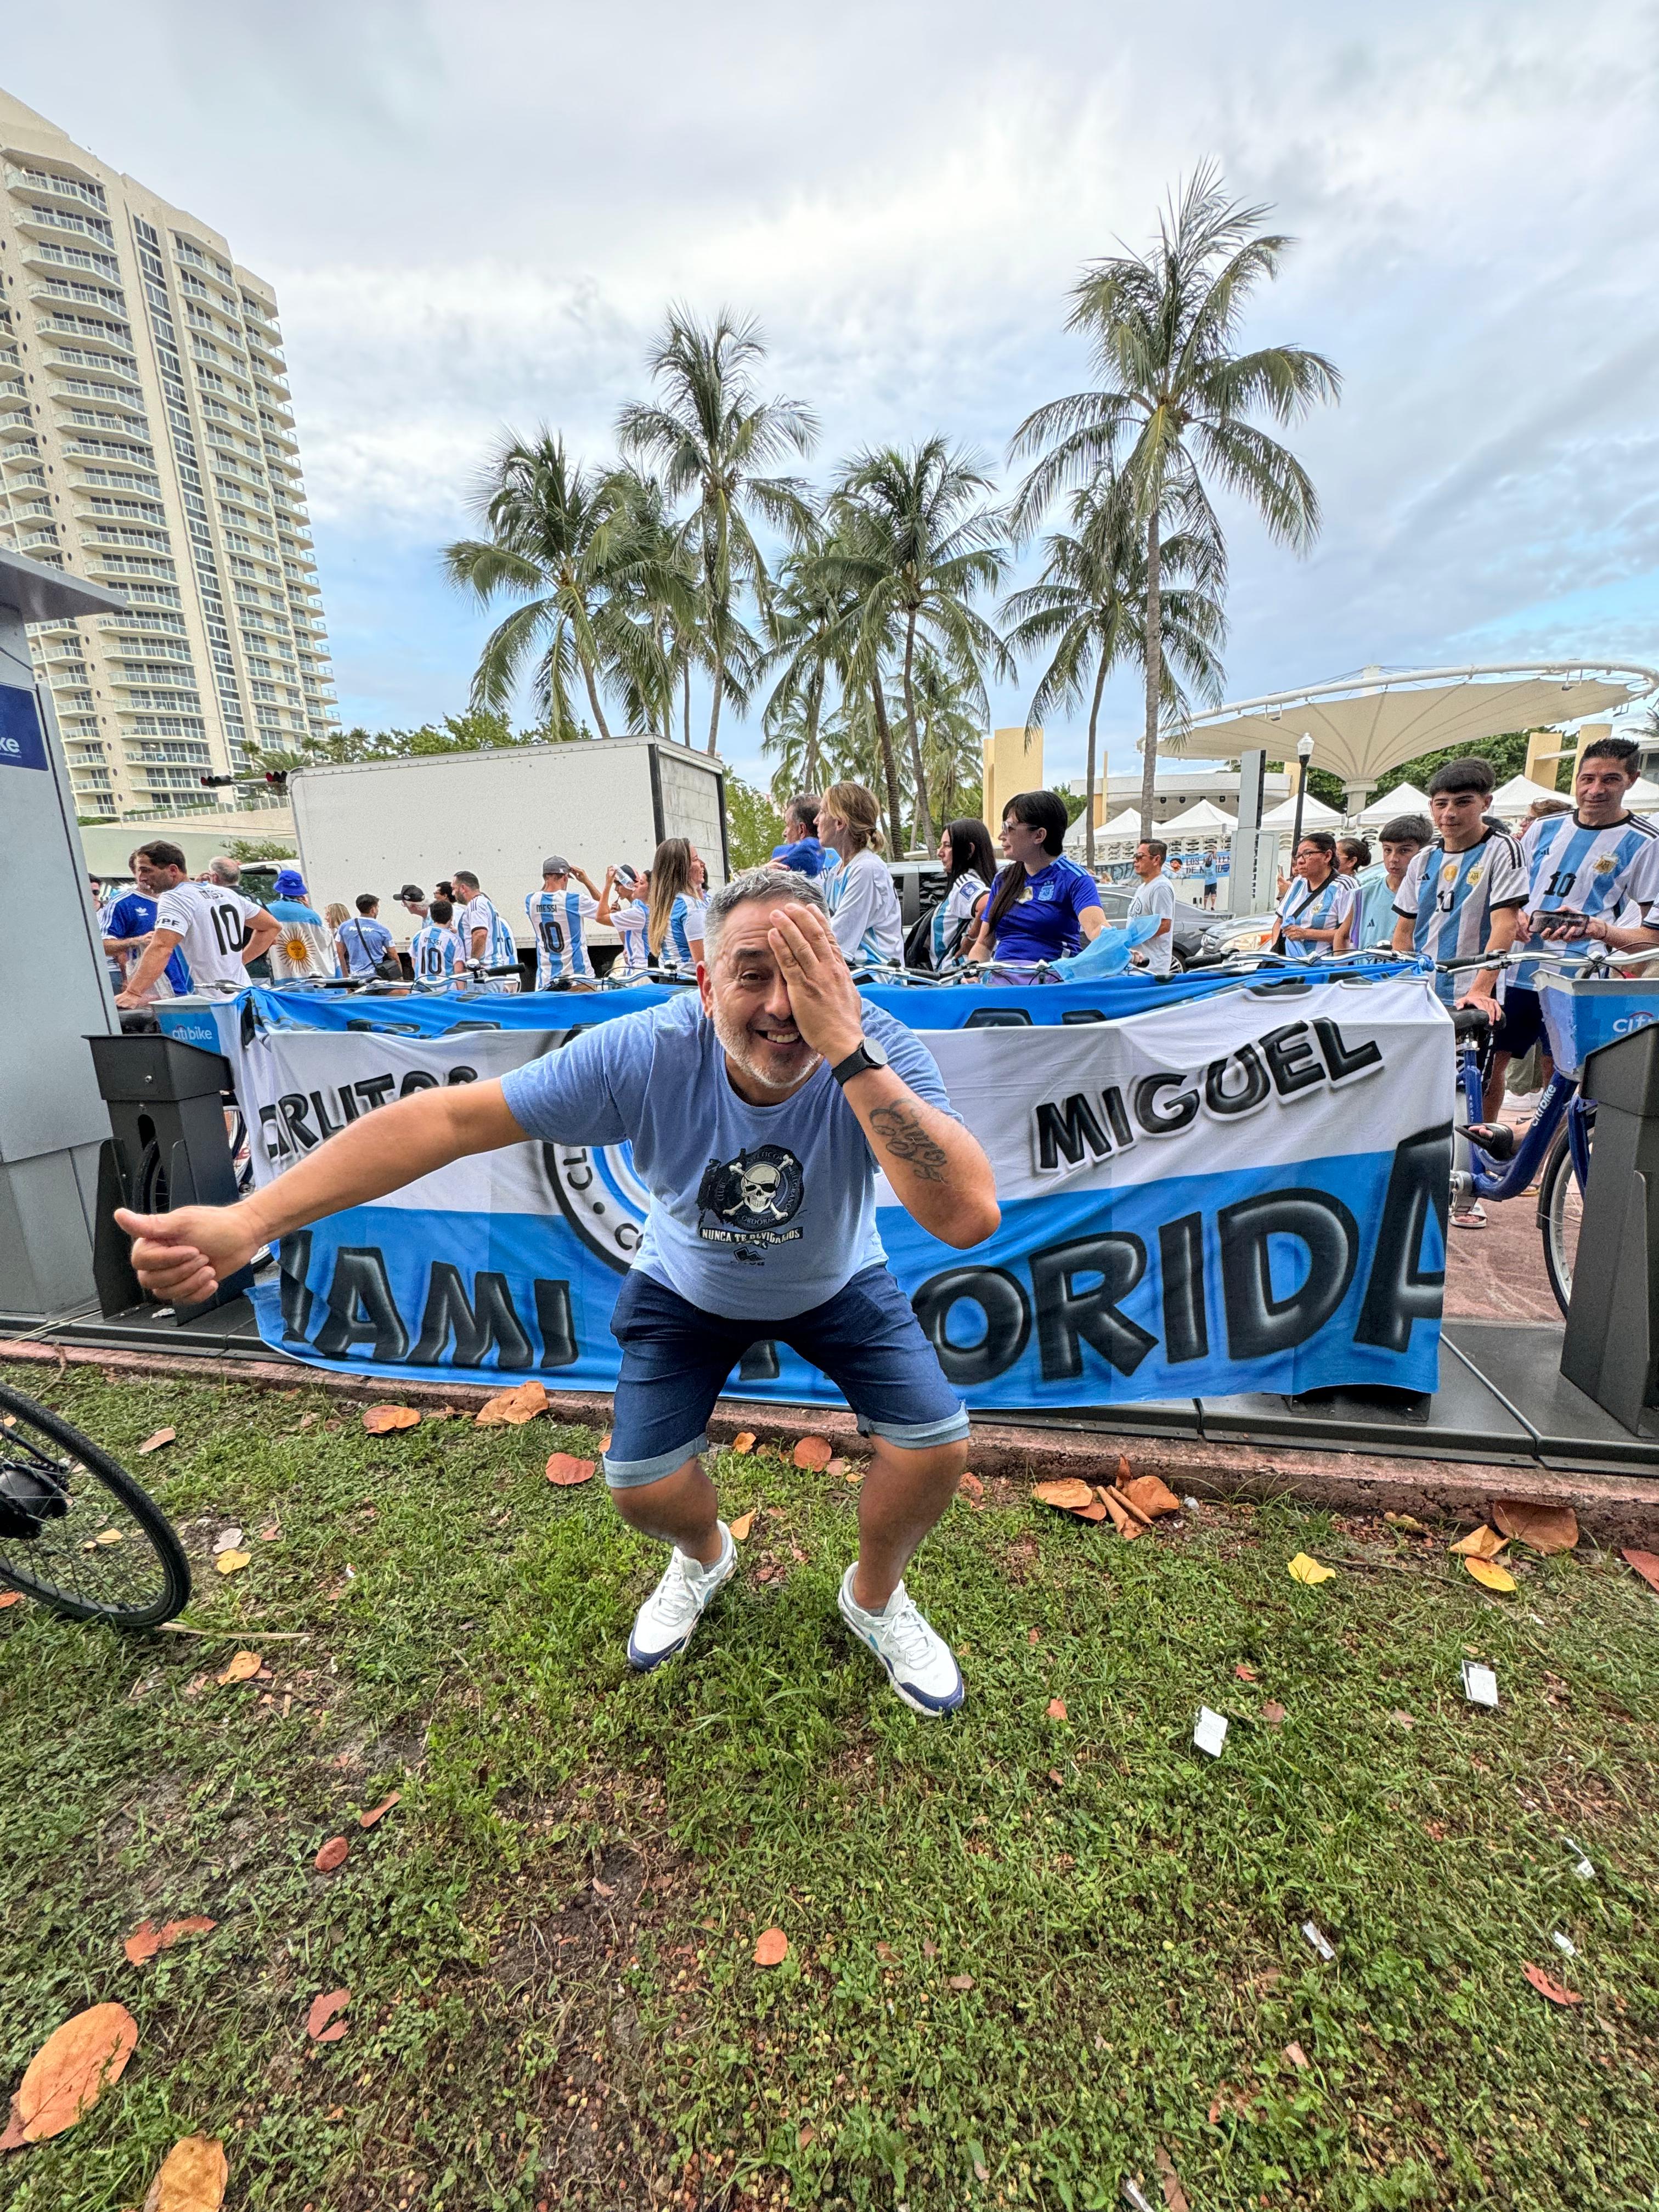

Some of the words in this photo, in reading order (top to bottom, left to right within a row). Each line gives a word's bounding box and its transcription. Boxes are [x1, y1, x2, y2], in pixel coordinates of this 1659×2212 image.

[1543, 871, 1577, 898] 10
[536, 904, 558, 913] MESSI
[210, 904, 243, 956] 10
[424, 936, 442, 946] MESSI
[539, 921, 565, 953] 10
[421, 946, 442, 974] 10
[187, 1026, 213, 1040] bike
[1039, 1017, 1383, 1169] MIGUEL
[702, 1228, 732, 1242] NUNCA
[734, 1233, 747, 1242] TE
